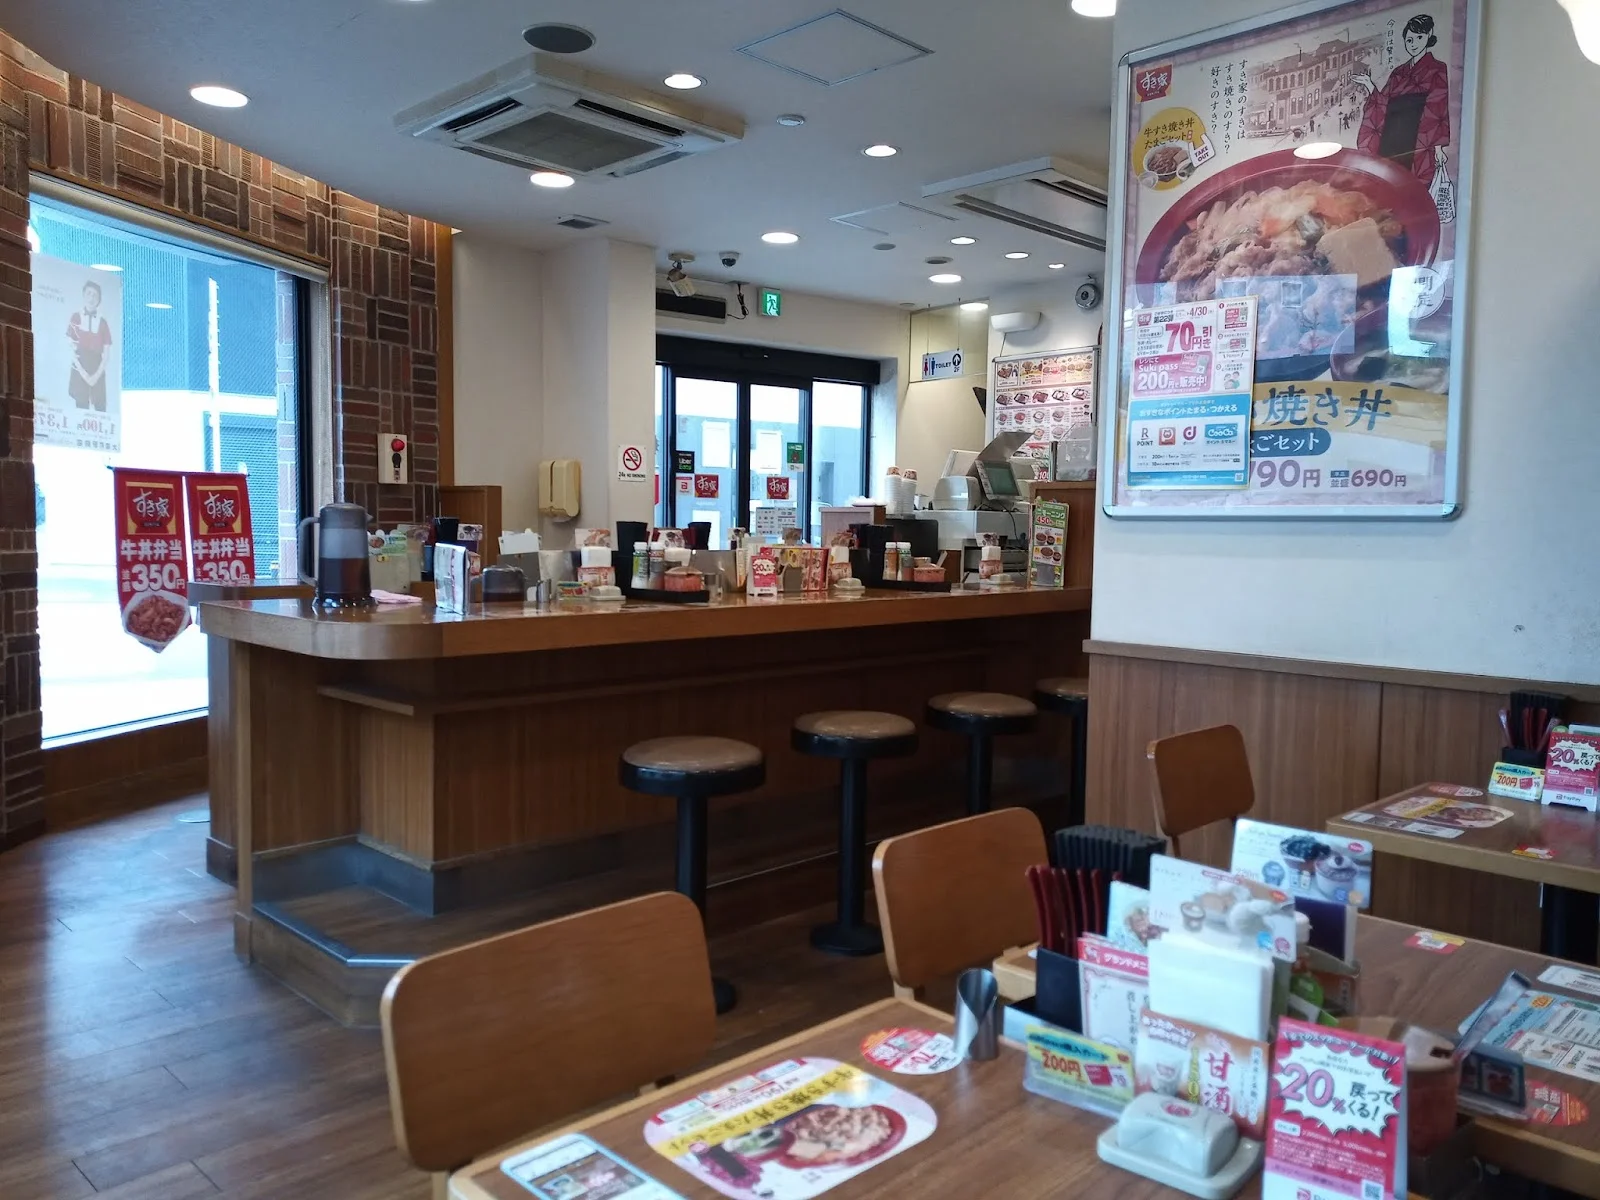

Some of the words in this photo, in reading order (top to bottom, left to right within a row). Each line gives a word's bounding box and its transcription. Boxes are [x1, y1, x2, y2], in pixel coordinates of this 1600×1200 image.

[1141, 71, 1168, 92] すき家
[1237, 59, 1248, 140] すき家のすきは
[1144, 117, 1195, 138] 牛すき焼き丼
[1145, 131, 1187, 149] たまごセット
[1195, 146, 1209, 159] TAKE
[1198, 152, 1210, 162] OUT
[1165, 321, 1202, 352] 70円
[935, 361, 951, 369] TOILET
[1139, 364, 1157, 373] Suki
[1159, 363, 1179, 373] pass
[1252, 384, 1392, 431] 焼き丼
[1351, 469, 1407, 488] 690円
[132, 487, 170, 517] すき家
[204, 491, 235, 518] すき家
[120, 539, 184, 562] 牛丼弁当
[193, 537, 250, 560] 牛丼弁当
[131, 562, 186, 592] 350円
[1497, 774, 1518, 788] 200円
[1041, 1050, 1083, 1081] 200円
[1280, 1062, 1346, 1114] 20%
[1349, 1081, 1393, 1101] 戻って
[1347, 1099, 1380, 1121] くる!
